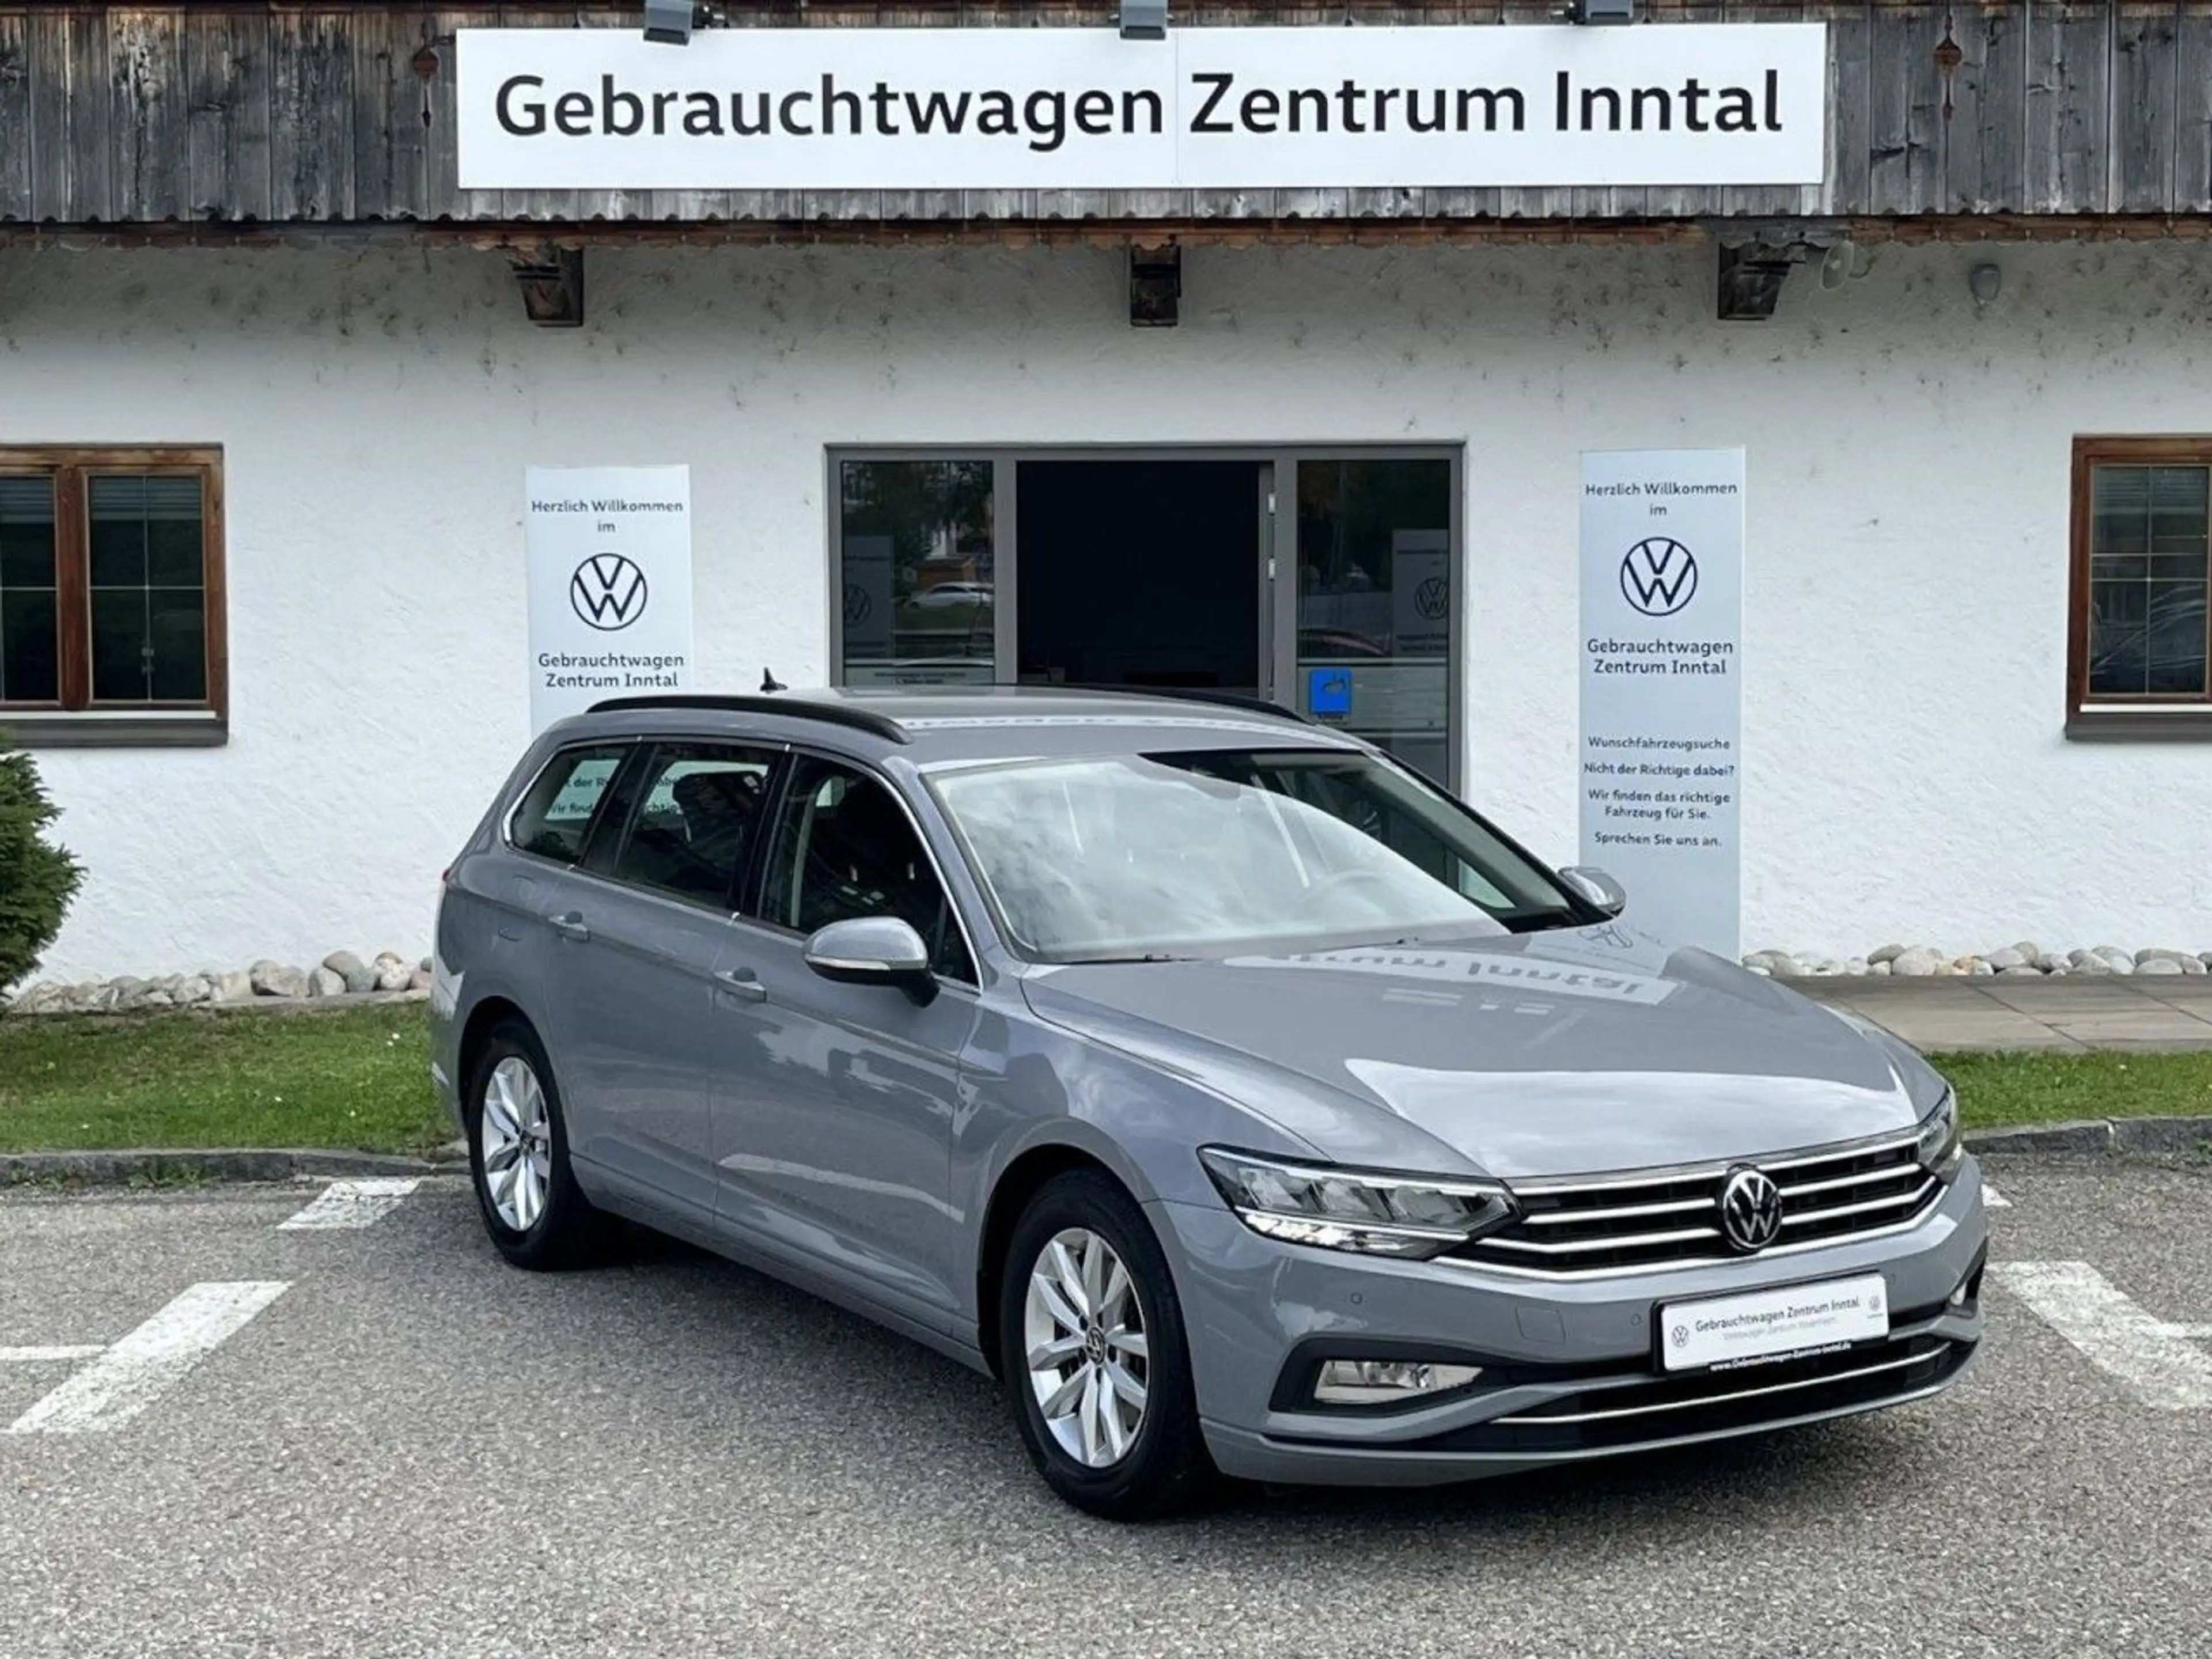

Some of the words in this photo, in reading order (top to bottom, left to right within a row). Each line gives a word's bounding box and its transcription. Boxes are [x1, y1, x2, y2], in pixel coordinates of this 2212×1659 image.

[496, 73, 1162, 152] Gebrauchtwagen
[1190, 73, 1525, 134] Zentrum
[1556, 69, 1782, 132] Inntal
[1585, 483, 1641, 496] Herzlich
[1644, 482, 1737, 495] Willkommen
[531, 499, 588, 513] Herzlich
[590, 499, 683, 512] Willkommen
[1650, 503, 1668, 516] im
[597, 520, 616, 533] im
[1620, 537, 1698, 617] VW
[570, 552, 648, 631] VW
[1587, 638, 1733, 658] Gebrauchtwagen
[538, 652, 684, 671] Gebrauchtwagen
[1593, 658, 1666, 675] Zentrum
[1672, 658, 1726, 675] Inntal
[546, 673, 619, 688] Zentrum
[624, 671, 678, 687] Inntal
[1588, 736, 1730, 752] Wunschfahrzeugsuche
[1584, 762, 1615, 775] Nicht
[1617, 763, 1638, 775] der
[1639, 763, 1691, 779] Richtige
[1693, 764, 1734, 777] dabei?
[1588, 789, 1609, 800] Wir
[1612, 789, 1652, 802] finden
[1654, 791, 1676, 802] das
[1679, 791, 1730, 806] richtige
[1605, 805, 1662, 821] Fahrzeug
[1665, 807, 1684, 819] für
[1688, 808, 1710, 819] Sie.
[1594, 831, 1651, 845] Sprechen
[1654, 834, 1673, 846] Sie
[1676, 837, 1699, 846] uns
[1702, 837, 1722, 846] an.
[1722, 1171, 1783, 1248] VW
[1695, 1306, 1785, 1332] Gebrauchtwagen
[1786, 1303, 1829, 1319] Zentrum
[1831, 1296, 1860, 1311] Inntal
